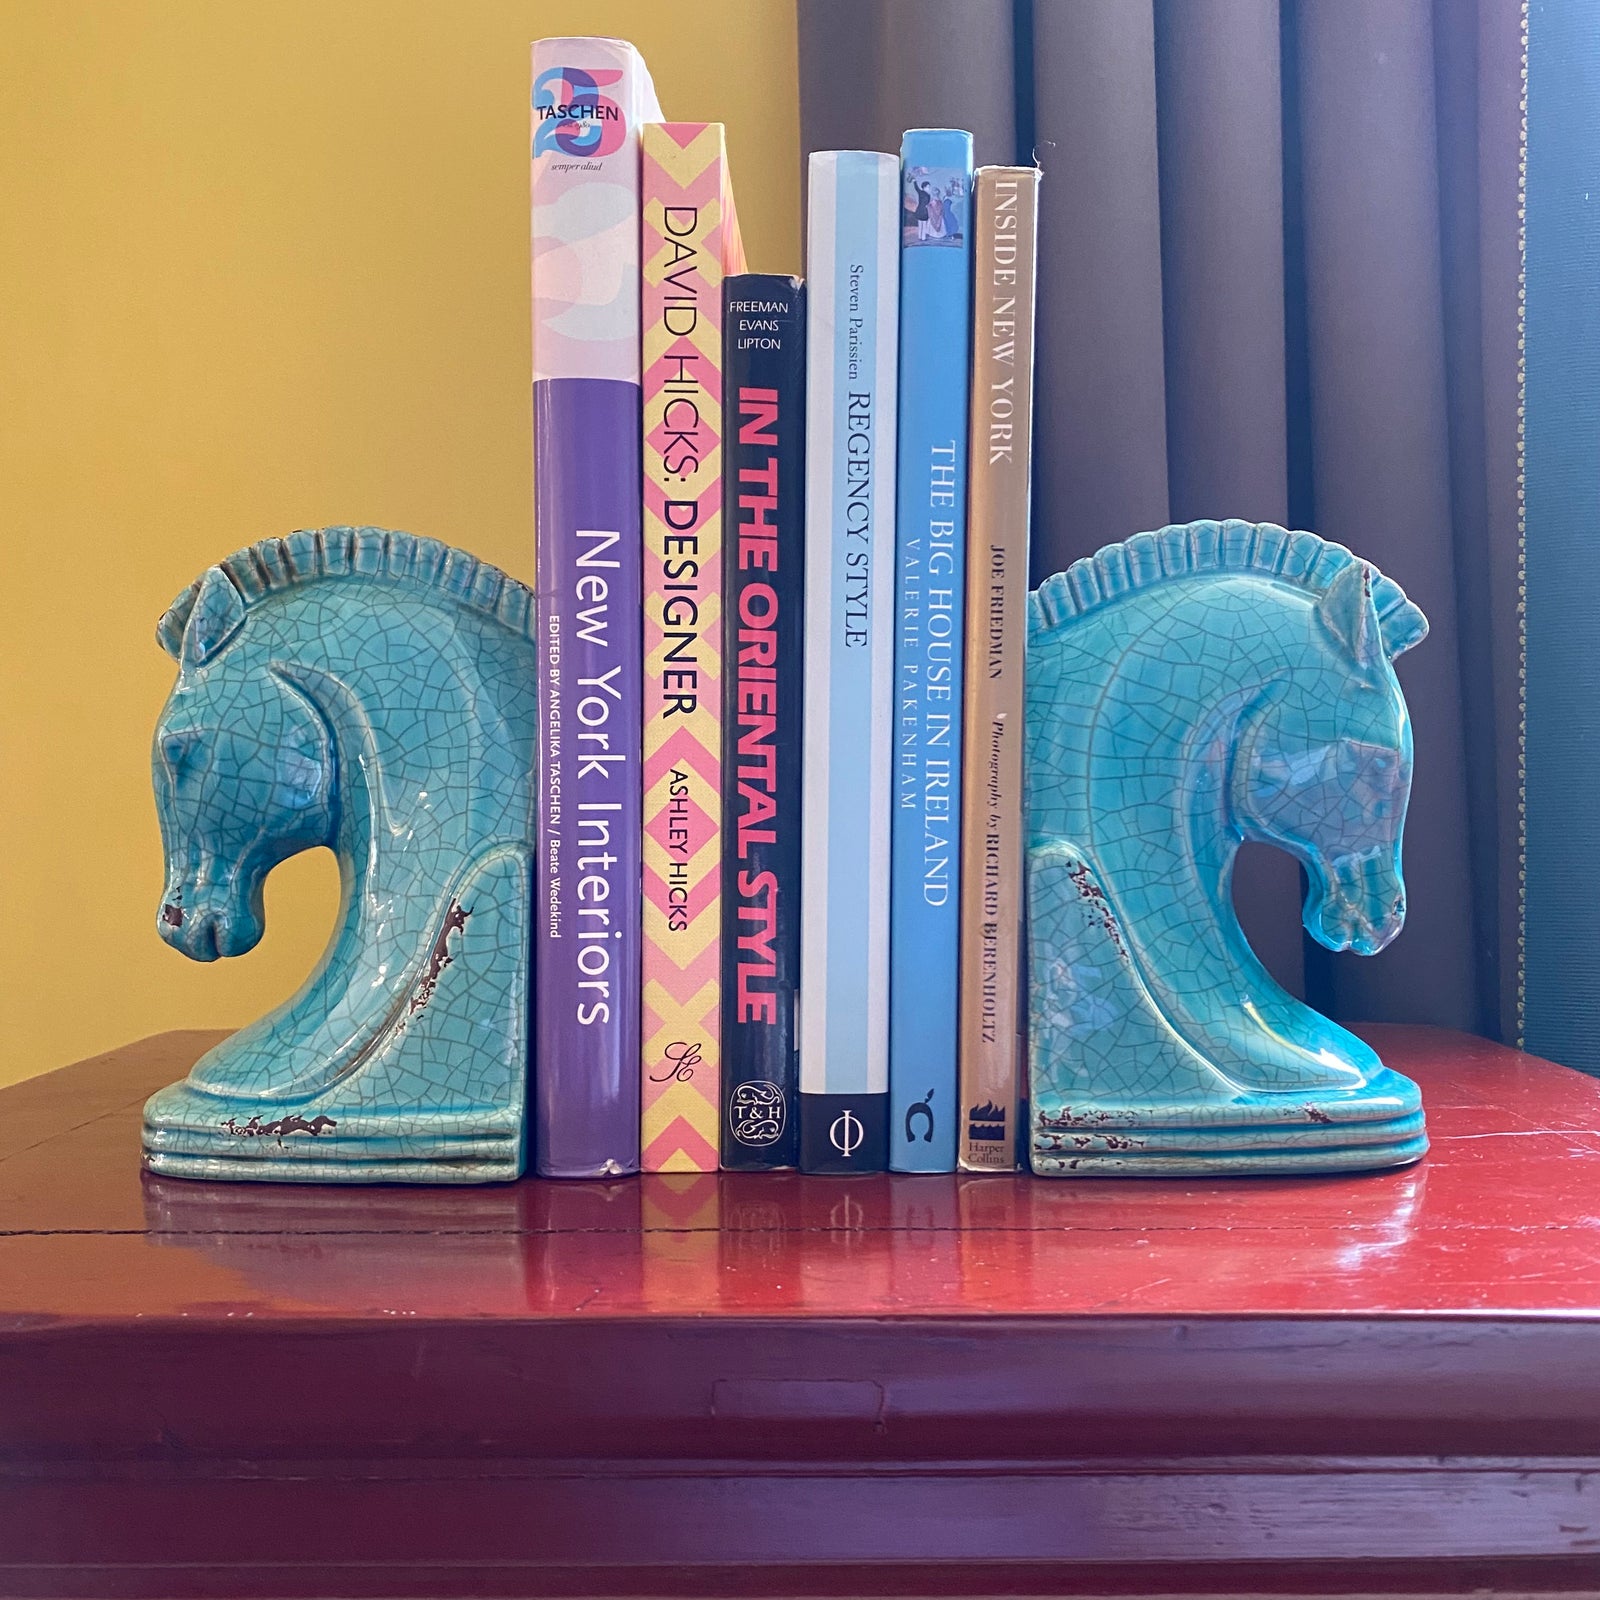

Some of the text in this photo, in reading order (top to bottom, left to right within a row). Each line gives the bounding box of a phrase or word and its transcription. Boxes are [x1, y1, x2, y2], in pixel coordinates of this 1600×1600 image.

[537, 104, 619, 121] TASCHEN
[729, 301, 788, 313] FREEMAN
[739, 319, 779, 331] EVANS
[848, 264, 864, 380] Steven Parissien
[989, 181, 1018, 465] INSIDE NEW YORK
[737, 338, 781, 349] LIPTON
[663, 207, 699, 720] DAVID HICKS: DESIGNER
[845, 391, 871, 647] REGENCY STYLE
[549, 615, 560, 664] EDITED
[989, 545, 1005, 679] JOE FRIEDMAN
[549, 669, 560, 685] BY
[901, 538, 920, 809] VALERIE PAKENHAM
[924, 439, 955, 907] THE BIG HOUSE IN IRELAND
[549, 689, 561, 757] ANGELIKA
[737, 387, 778, 1025] IN THE ORIENTAL STYLE
[549, 761, 561, 824] TASCHEN
[576, 530, 626, 1025] New York Interiors
[549, 840, 561, 874] Beate
[669, 768, 689, 931] ASHLEY HICKS
[550, 878, 562, 938] Wedekind
[982, 721, 1004, 1044] Photography by RICHARD BERENHOLTZ
[734, 1106, 781, 1119] T & H
[968, 1142, 1005, 1153] Harper
[968, 1153, 1005, 1164] Collins
